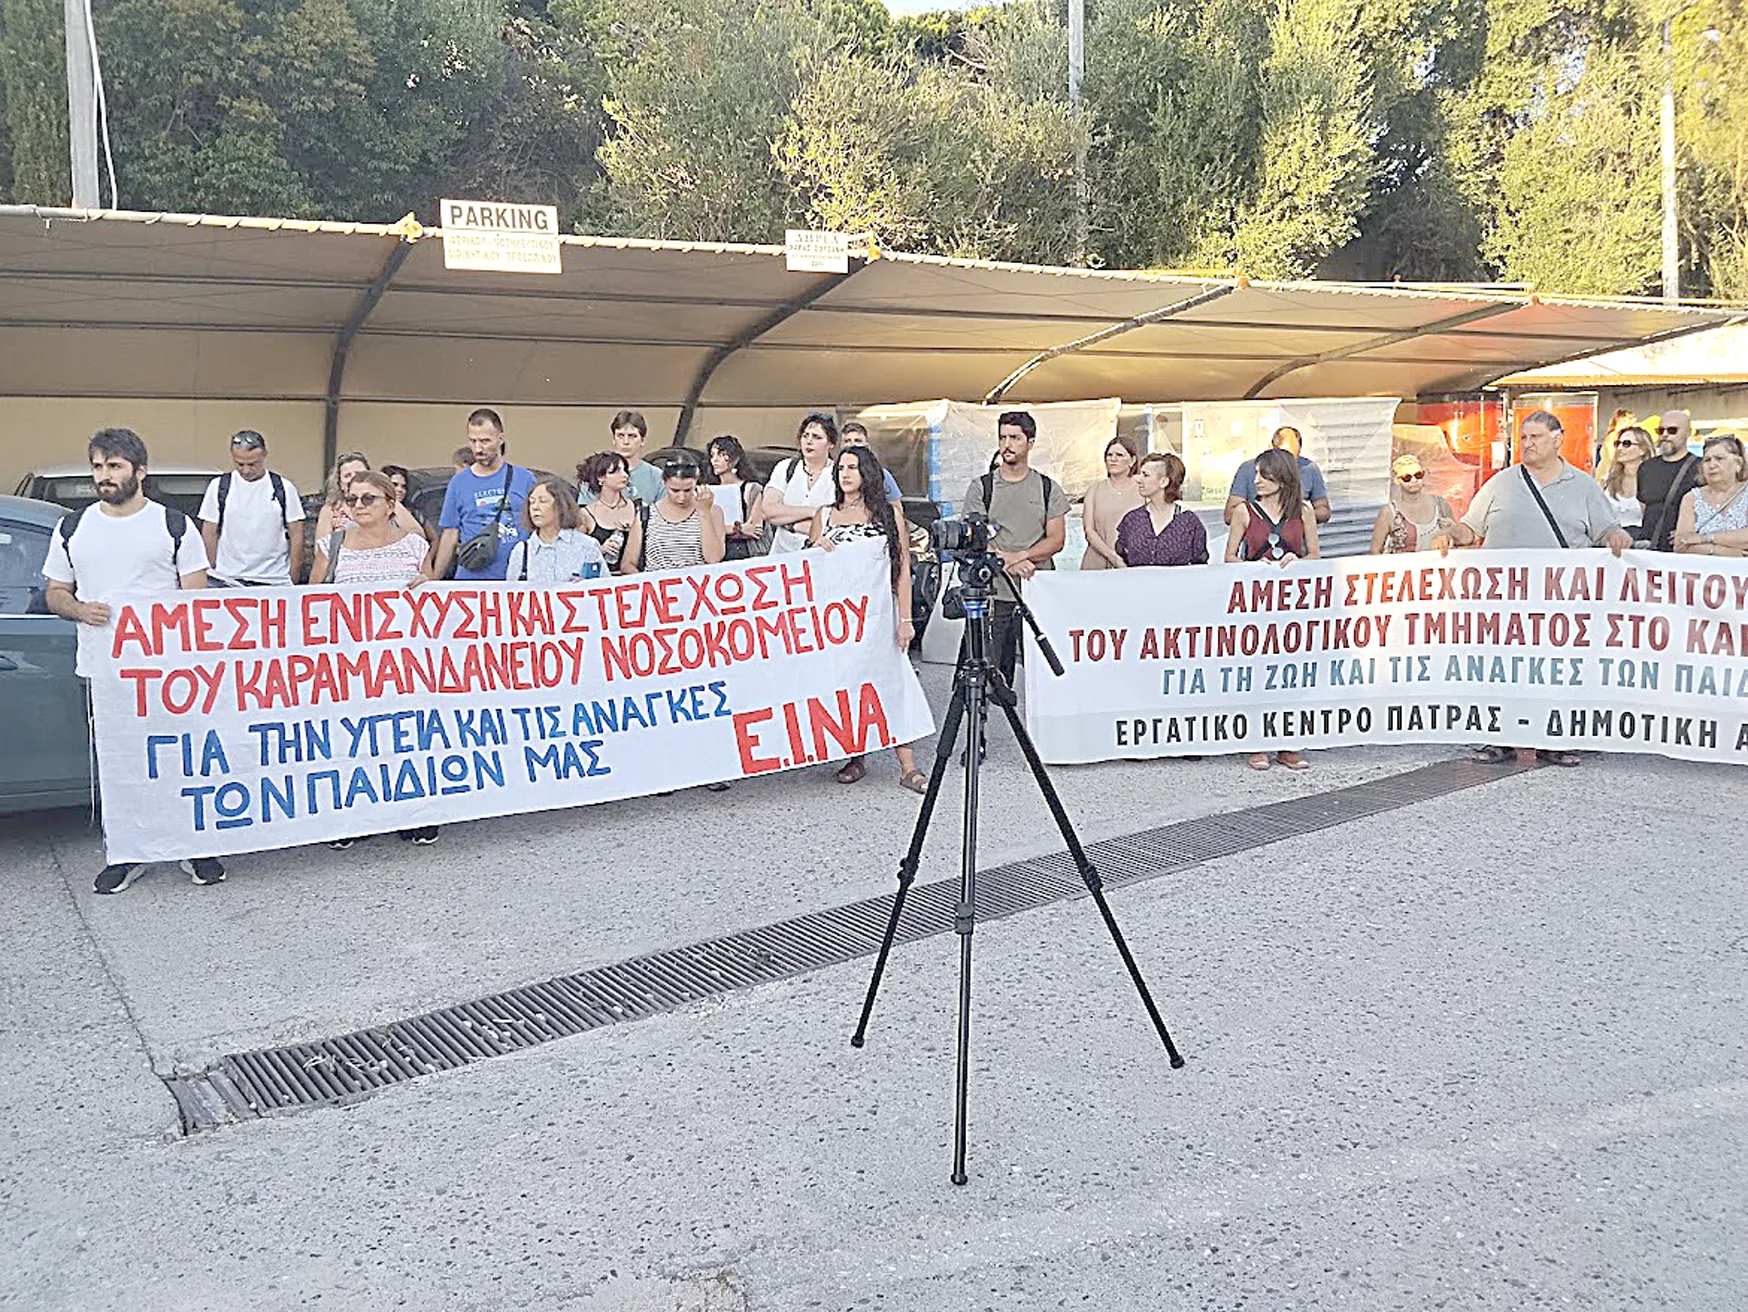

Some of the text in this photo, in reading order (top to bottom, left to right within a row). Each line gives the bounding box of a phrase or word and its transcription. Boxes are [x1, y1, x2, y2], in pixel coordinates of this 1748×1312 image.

[450, 205, 548, 230] PARKING
[112, 560, 815, 658] ΑΜΕΣΗ ΕΝΙΣΧΥΣΗ ΚΑΙ ΣΤΕΛΕΧΩΣΗ
[1227, 575, 1334, 614] ΑΜΕΣΗ
[1344, 567, 1529, 607] ΣΤΕΛΕΧΩΣΗ
[1545, 566, 1605, 601] ΚΑΙ
[120, 596, 869, 717] ΤΟΥ ΚΑΡΑΜΑΝΔΑΝΕΙΟΥ ΝΟΣΟΚΟΜΕΙΟΥ
[1069, 628, 1128, 662] ΤΟΥ
[1139, 614, 1392, 661] ΑΚΤΙΝΟΛΟΓΙΚΟΥ
[1405, 612, 1591, 647] ΤΜΗΜΑΤΟΣ
[1606, 613, 1669, 652] ΣΤΟ
[1163, 668, 1206, 695] ΓΙΑ
[1220, 666, 1253, 693] ΤΗ
[1265, 661, 1317, 690] ΖΩΗ
[1330, 657, 1375, 686] ΚΑΙ
[1389, 655, 1431, 683] ΤΙΣ
[1445, 655, 1584, 687] ΑΝΑΓΚΕΣ
[1599, 657, 1659, 691] ΤΩΝ
[147, 681, 733, 779] ΓΙΑ ΤΗΝ ΥΓΕΙΑ ΚΑΙ ΤΙΣ ΑΝΑΓΚΕΣ
[1116, 713, 1248, 746] ΕΡΓΑΤΙΚΟ
[1263, 706, 1373, 738] ΚΕΝΤΡΟ
[1387, 705, 1502, 732] ΠΑΤΡΑΣ
[1518, 718, 1529, 726] -
[1546, 709, 1717, 749] ΔΗΜΟΤΙΚΗ
[182, 740, 612, 831] ΤΩΝ ΠΑΙΔΙΩΝ ΜΑΣ
